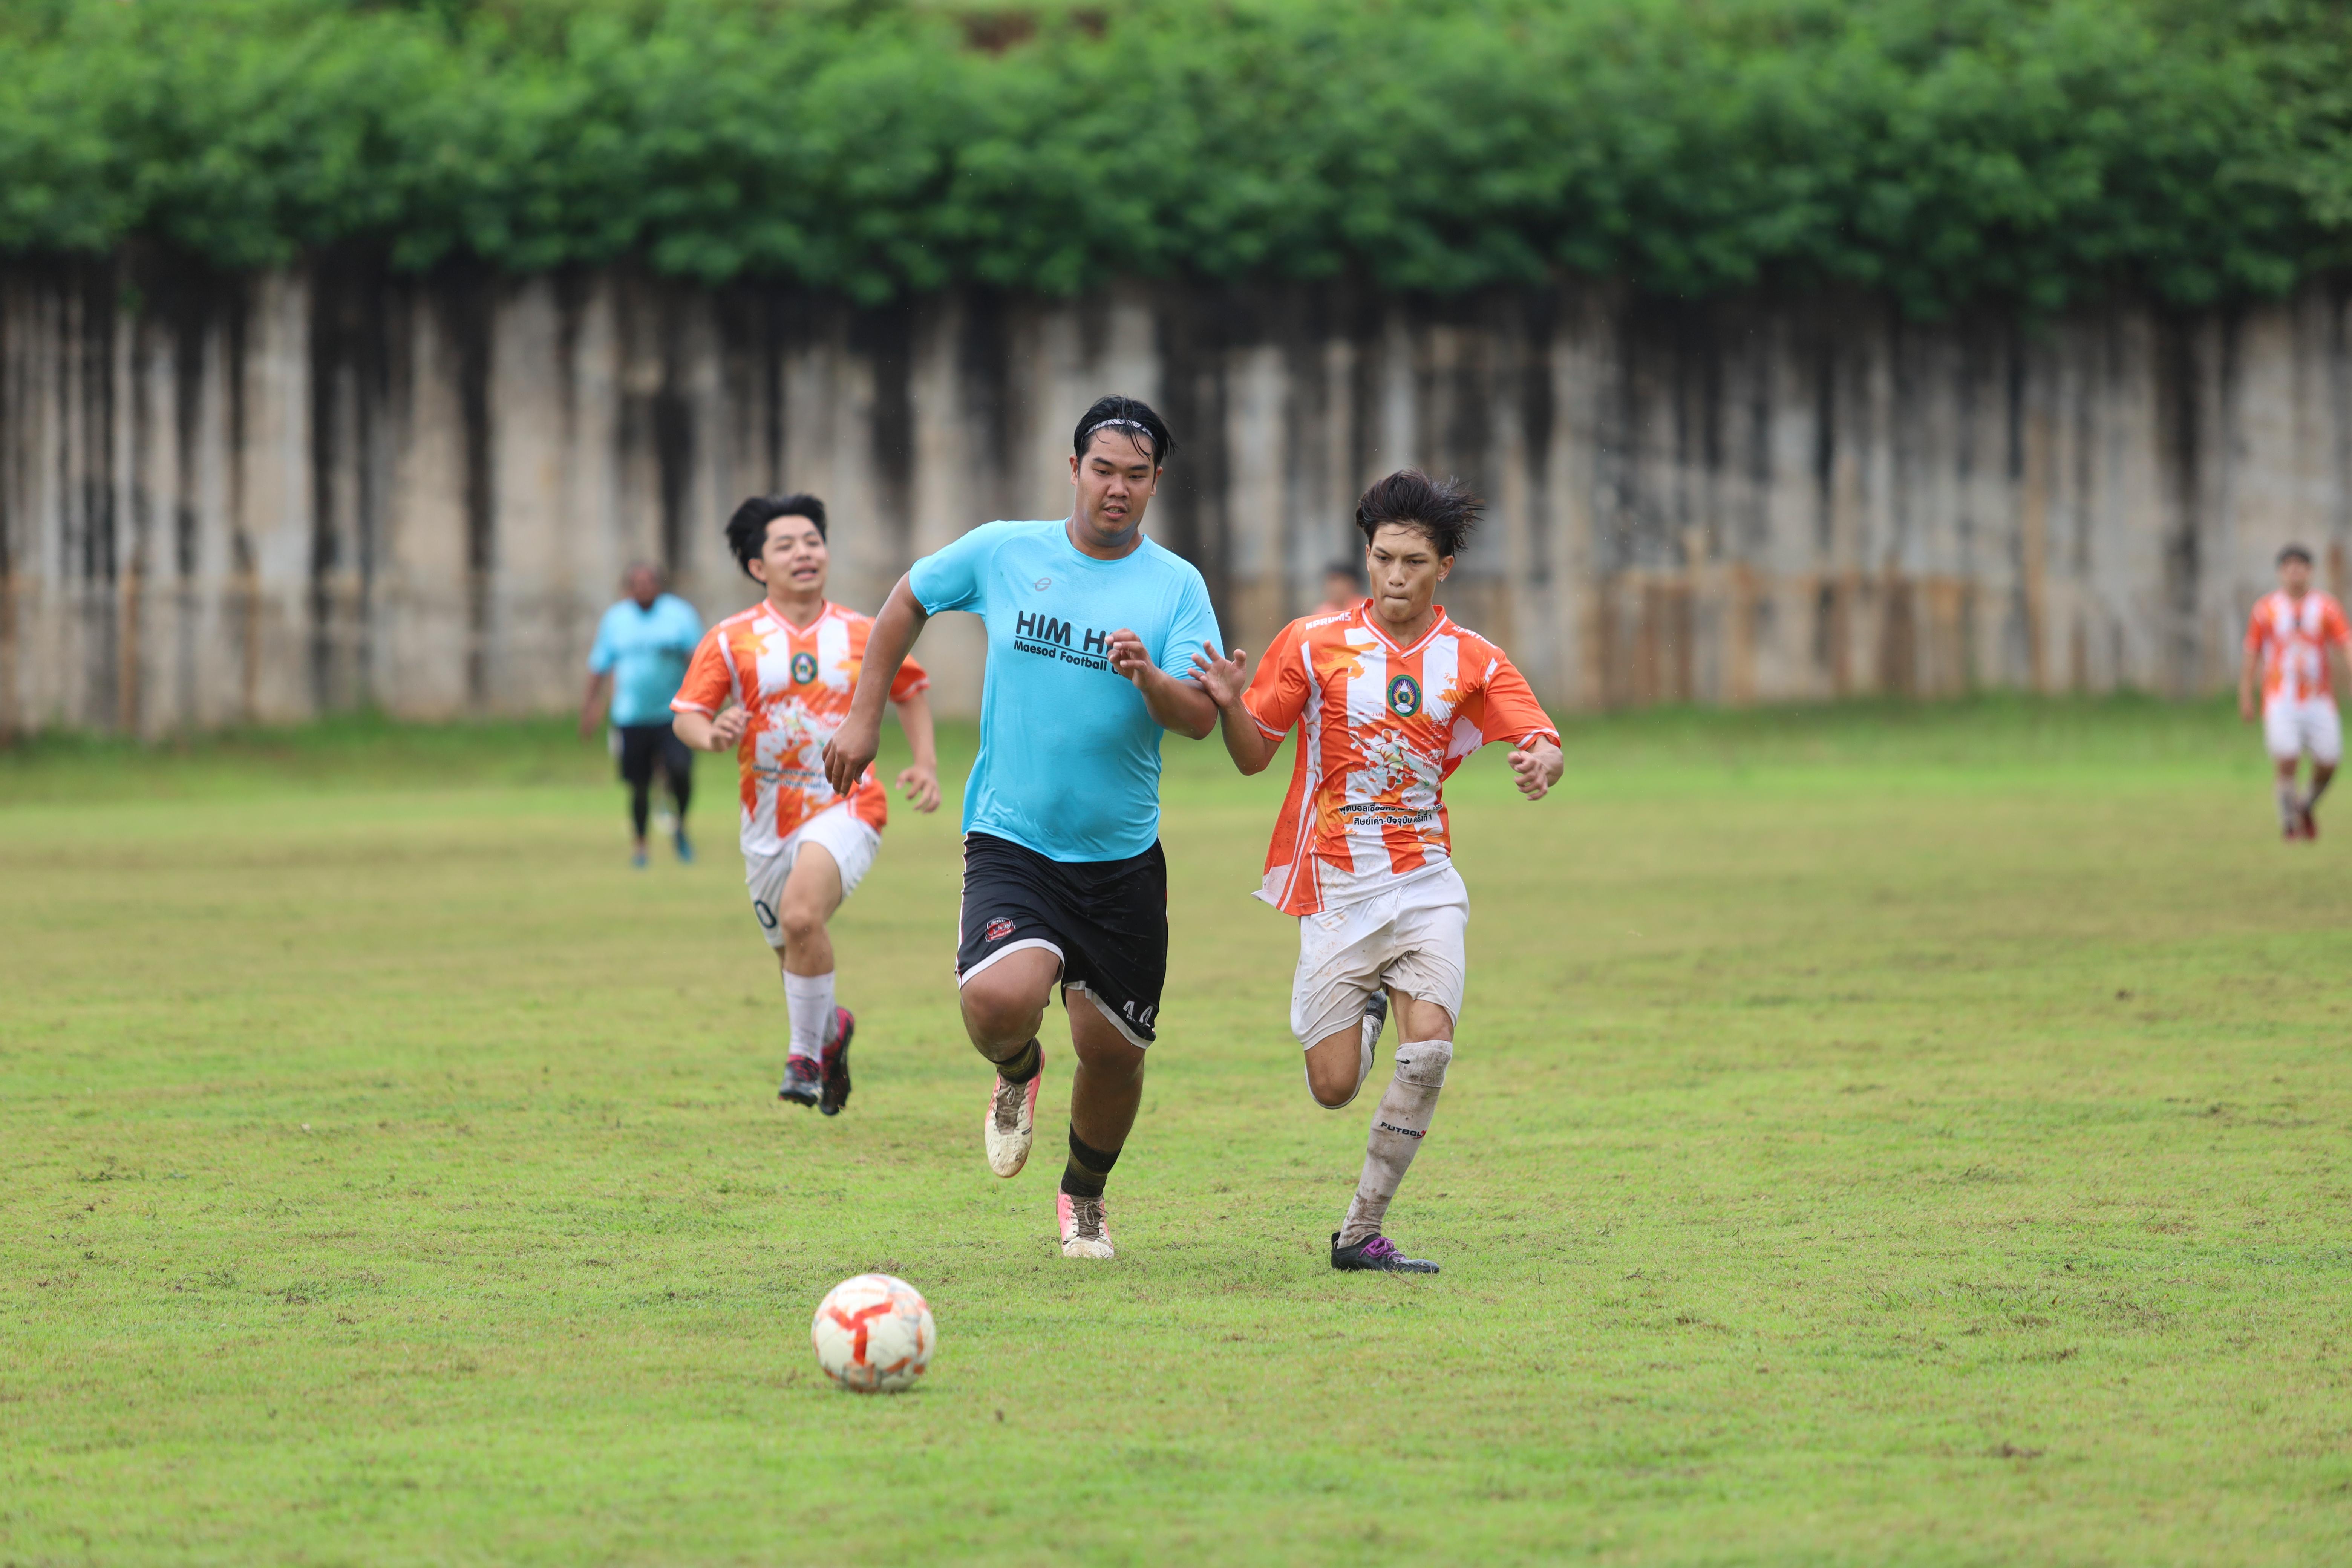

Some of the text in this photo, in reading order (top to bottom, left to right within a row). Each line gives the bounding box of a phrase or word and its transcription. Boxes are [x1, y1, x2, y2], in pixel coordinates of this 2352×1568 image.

[1016, 610, 1114, 655] HIM H
[1014, 640, 1056, 658] Maesod
[1060, 651, 1107, 671] Football
